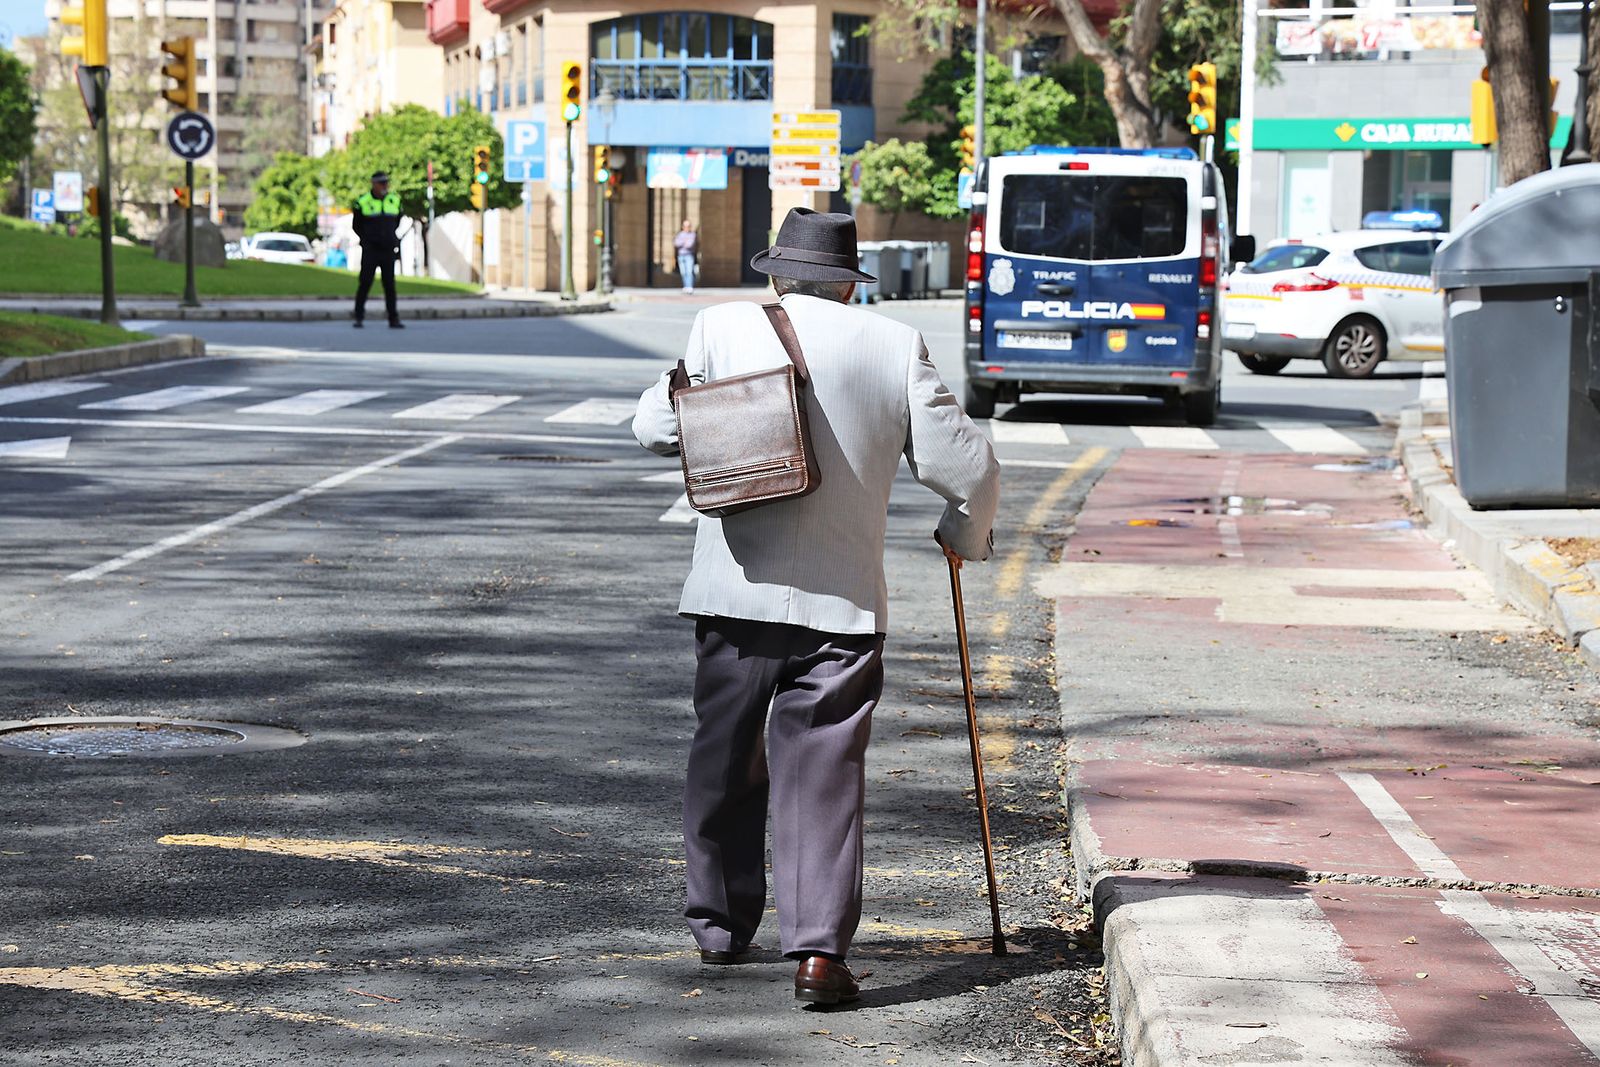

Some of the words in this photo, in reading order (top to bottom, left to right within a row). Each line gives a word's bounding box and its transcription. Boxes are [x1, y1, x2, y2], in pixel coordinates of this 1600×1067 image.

[514, 123, 539, 154] P
[1361, 123, 1411, 143] CAJA
[1032, 271, 1077, 281] TRAFIC
[1148, 273, 1193, 284] RENAULT
[1021, 300, 1136, 320] POLICIA
